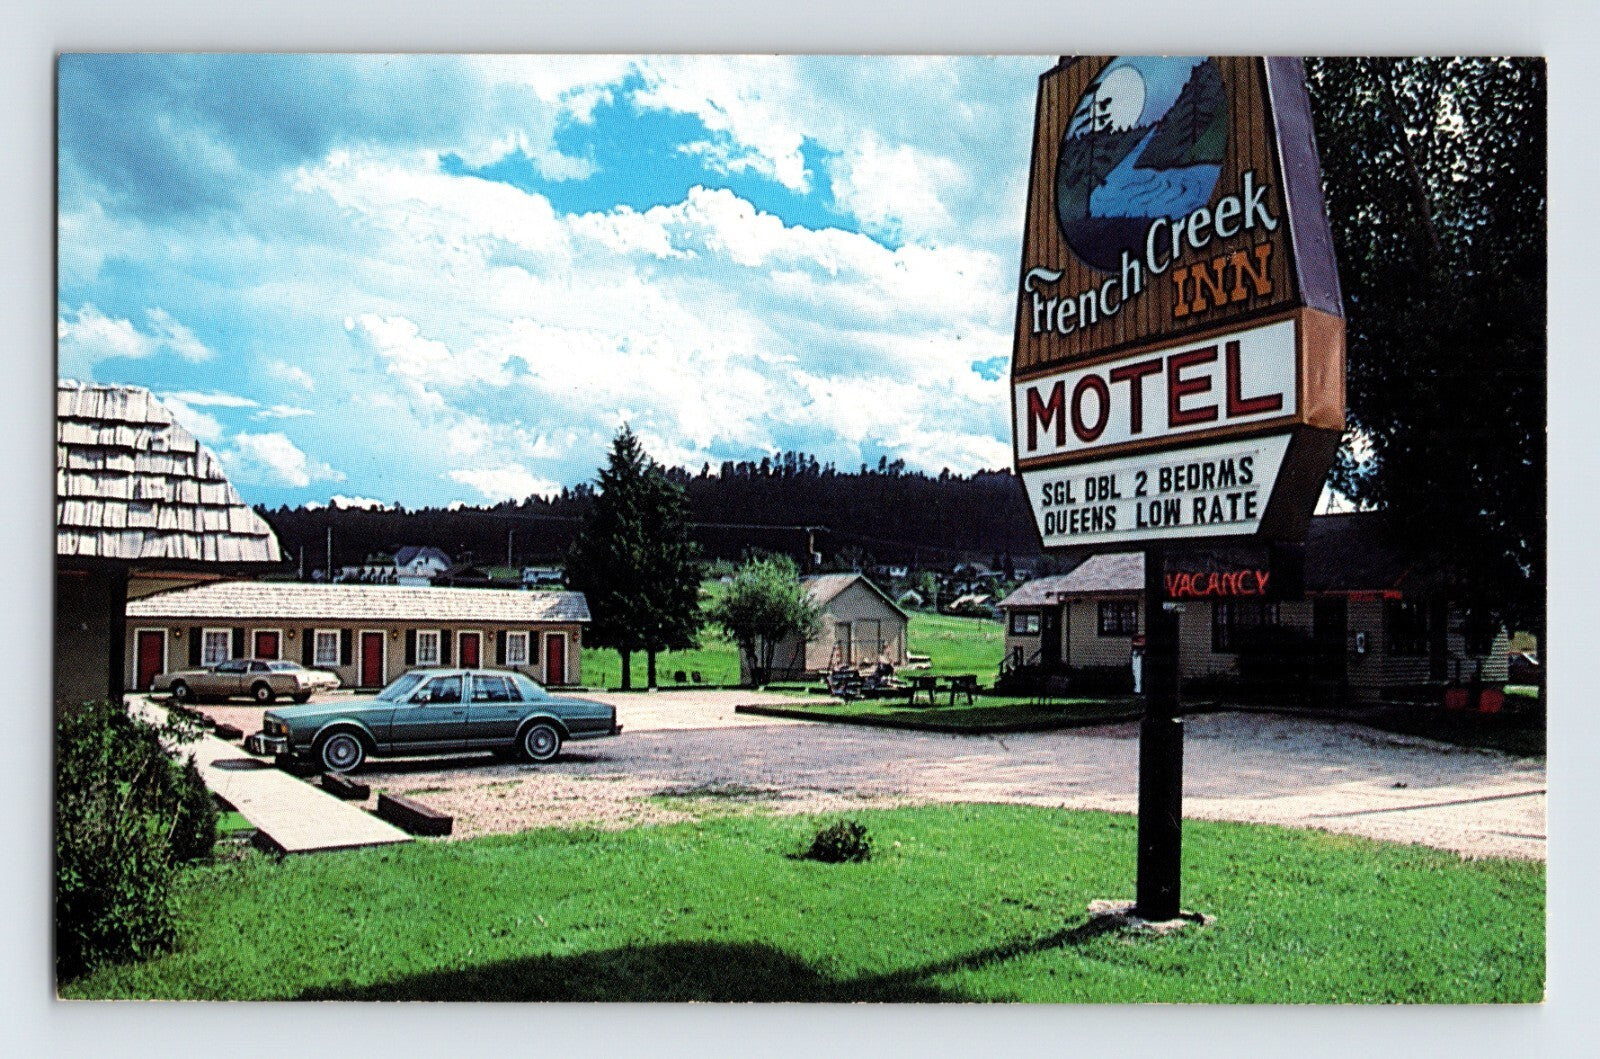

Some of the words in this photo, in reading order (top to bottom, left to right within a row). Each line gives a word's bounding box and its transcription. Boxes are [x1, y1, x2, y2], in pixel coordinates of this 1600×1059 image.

[1024, 251, 1142, 335] French
[1146, 171, 1278, 275] Creek
[1172, 244, 1273, 318] INN
[1027, 340, 1283, 451] MOTEL
[1042, 480, 1076, 507] SGL
[1085, 474, 1122, 502] DBL
[1135, 470, 1148, 497] 2
[1159, 456, 1254, 493] BEDRMS
[1044, 505, 1117, 536] QUEENS
[1136, 498, 1181, 527] LOW
[1192, 490, 1257, 523] RATE
[1165, 569, 1270, 597] VACANCY
